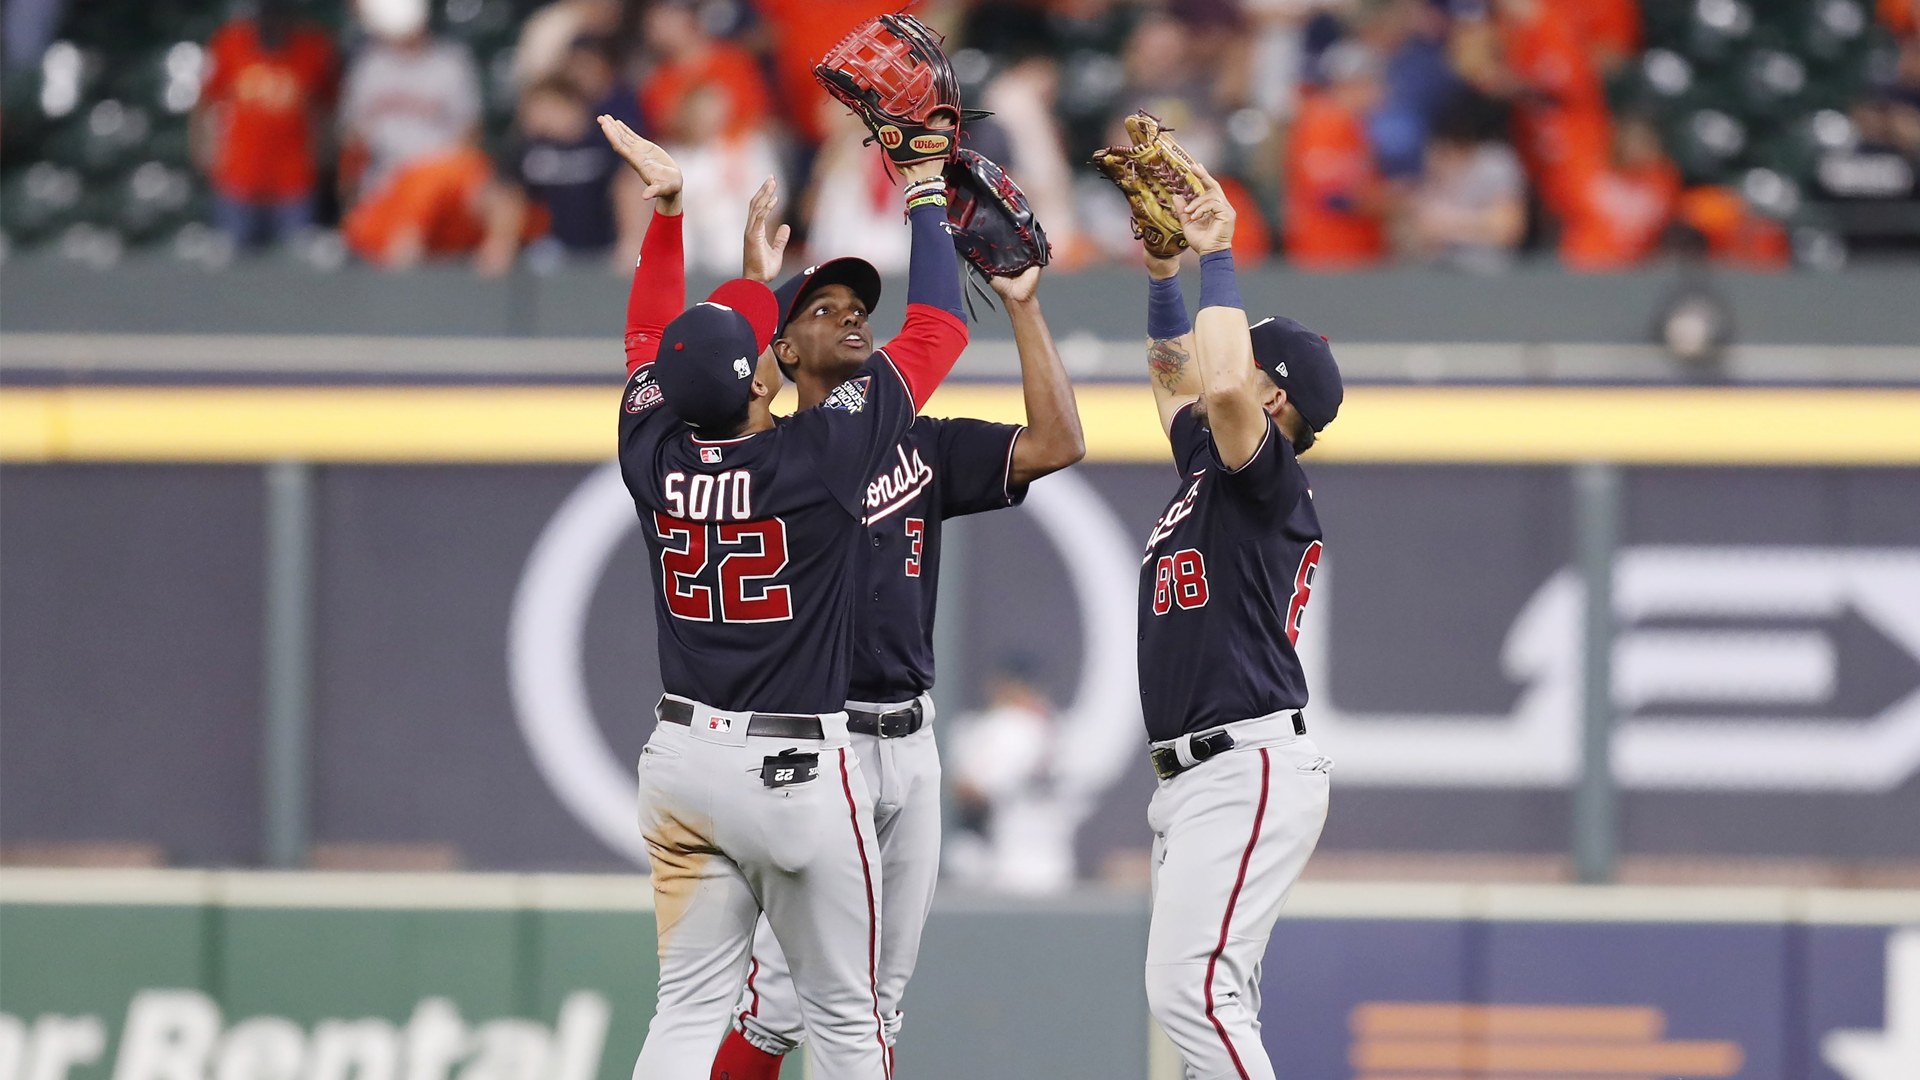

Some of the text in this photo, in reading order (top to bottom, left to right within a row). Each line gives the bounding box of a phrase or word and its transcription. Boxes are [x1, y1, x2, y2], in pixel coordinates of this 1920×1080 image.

[881, 131, 900, 145] W
[914, 140, 945, 149] Wilson
[832, 386, 858, 414] WORLD
[841, 380, 866, 406] SERIES
[664, 470, 752, 521] SOTO
[862, 443, 933, 522] onals
[653, 510, 794, 624] 22
[904, 517, 925, 578] 3
[1152, 548, 1209, 616] 88
[774, 768, 795, 781] 22
[112, 987, 612, 1080] Rental
